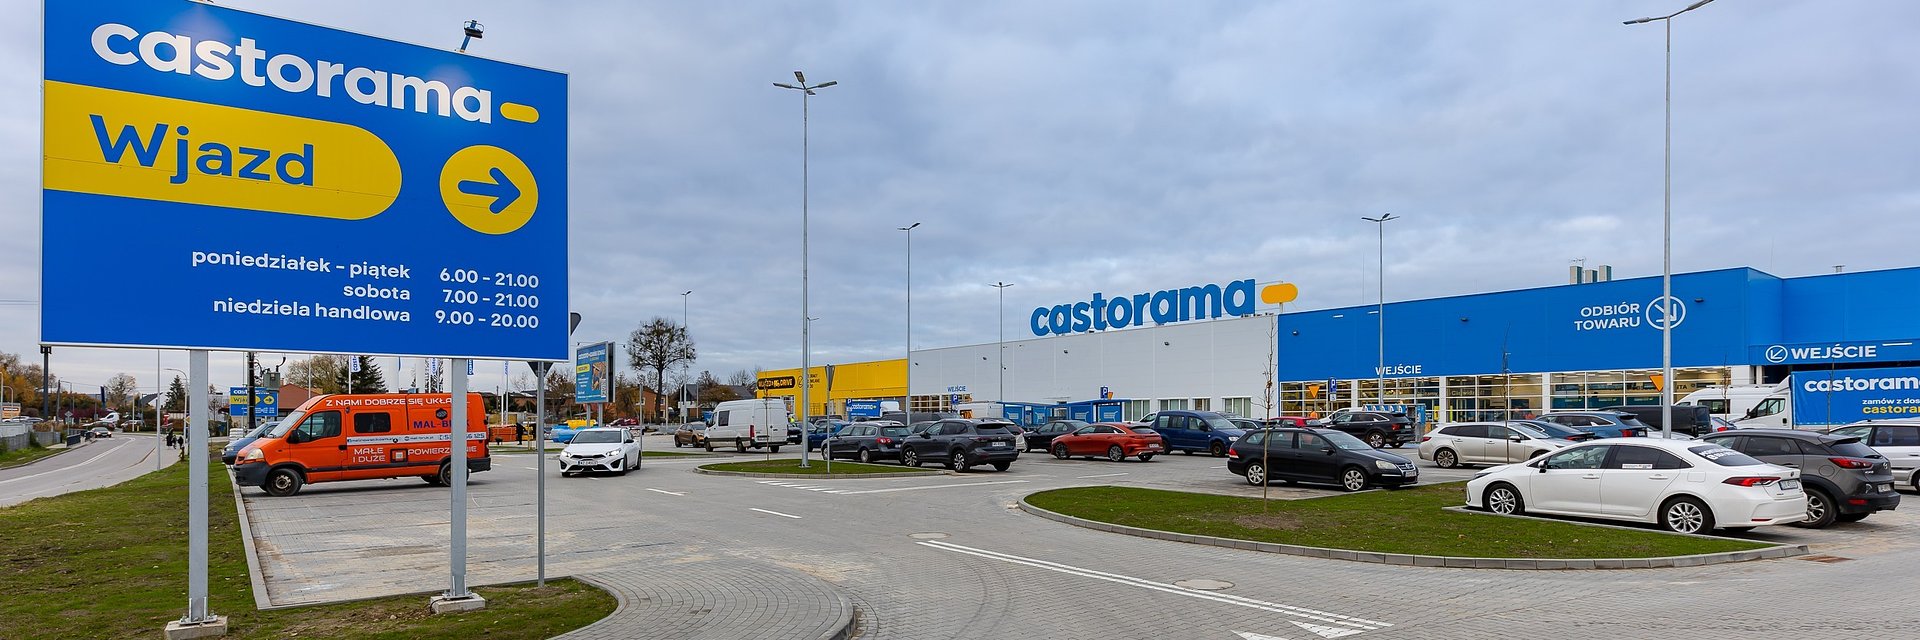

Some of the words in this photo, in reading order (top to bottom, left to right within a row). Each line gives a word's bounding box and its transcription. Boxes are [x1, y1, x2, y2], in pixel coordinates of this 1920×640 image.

[91, 22, 493, 125] castorama
[89, 114, 315, 187] Wjazd
[192, 249, 331, 273] poniedziałek
[349, 261, 411, 282] piątek
[439, 266, 479, 284] 6.00
[495, 272, 539, 289] 21.00
[343, 282, 411, 301] sobota
[442, 288, 479, 305] 7.00
[495, 292, 539, 309] 21.00
[213, 297, 311, 318] niedziela
[315, 302, 411, 323] handlowa
[435, 309, 474, 326] 9.00
[490, 313, 539, 329] 20.00
[1030, 278, 1256, 337] castorama
[1580, 301, 1640, 317] ODBIÓR
[1574, 316, 1641, 331] TOWARU
[1790, 343, 1877, 360] WEJŚCIE
[1375, 363, 1422, 376] WEJŚCIE
[1804, 376, 1920, 392] castoram
[407, 398, 424, 406] SIĘ
[1862, 397, 1895, 405] zamów
[1862, 405, 1920, 414] castora
[413, 420, 470, 429] MAL-B
[354, 447, 384, 455] MAŁE
[358, 455, 386, 463] DUŻE
